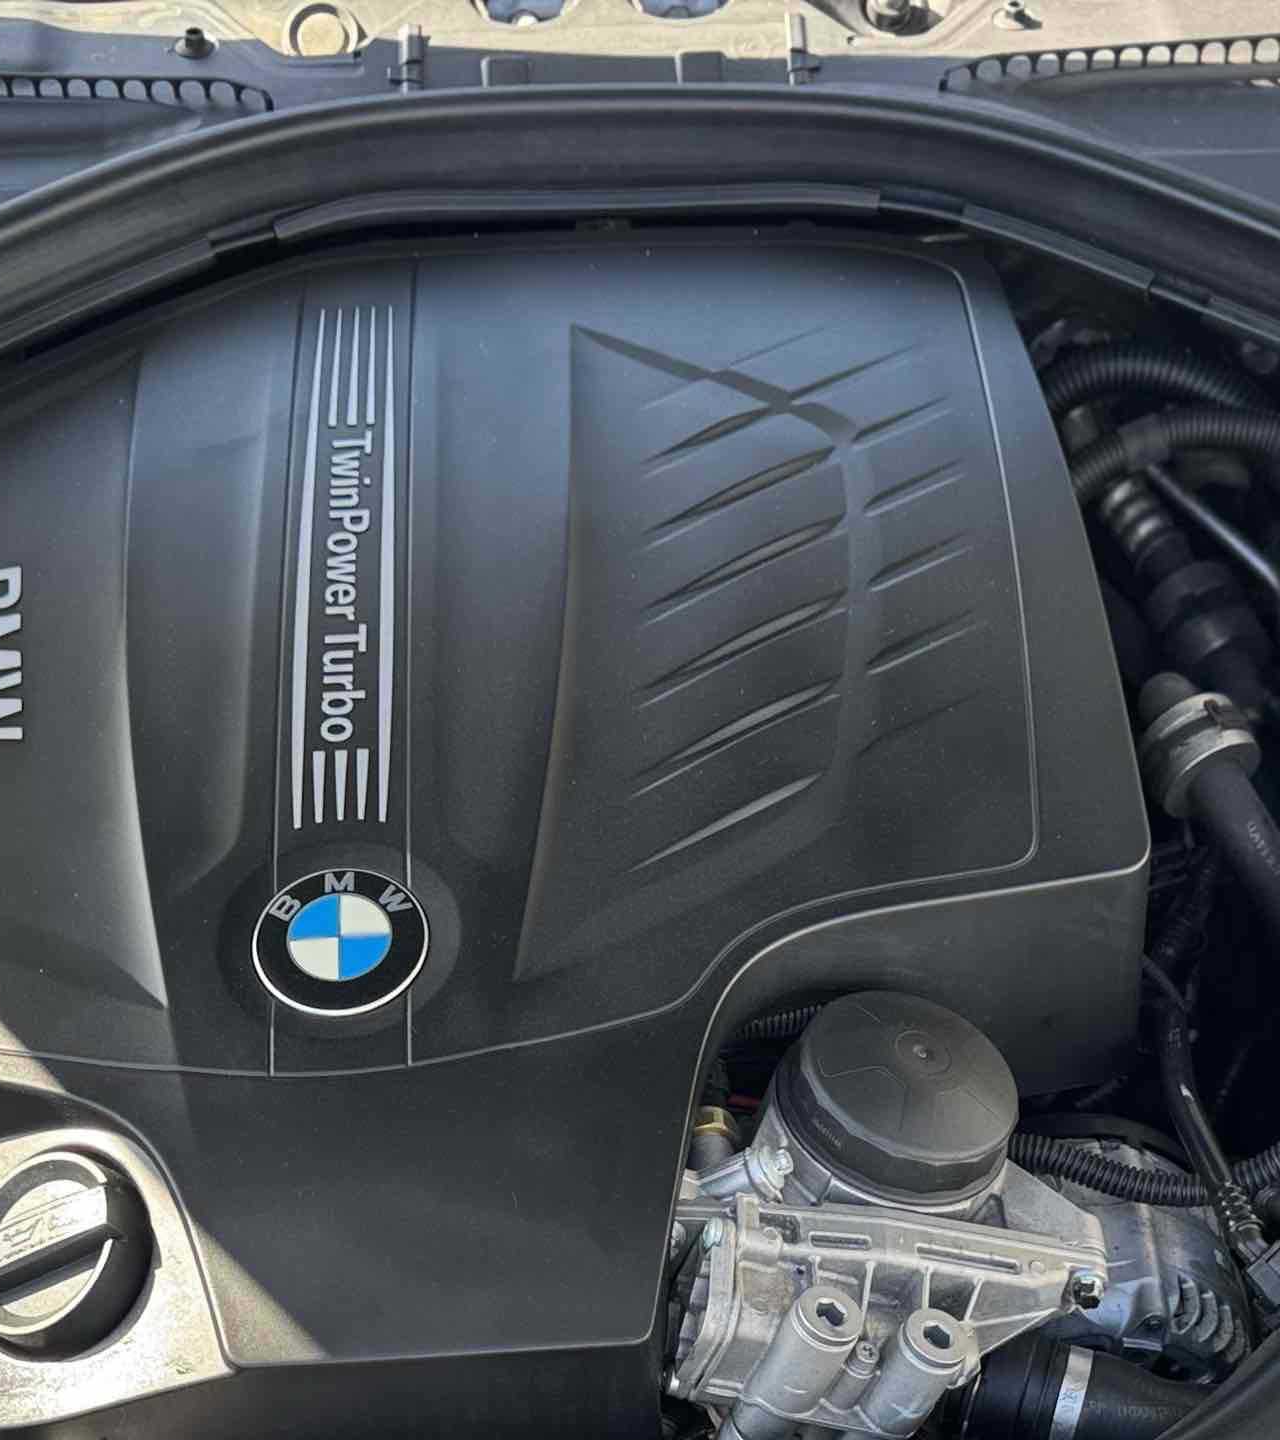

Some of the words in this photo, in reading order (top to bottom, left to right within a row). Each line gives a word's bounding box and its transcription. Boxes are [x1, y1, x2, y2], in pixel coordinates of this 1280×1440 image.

[324, 430, 373, 620] TwinPower
[320, 623, 368, 742] Turbo
[269, 871, 413, 921] BMW
